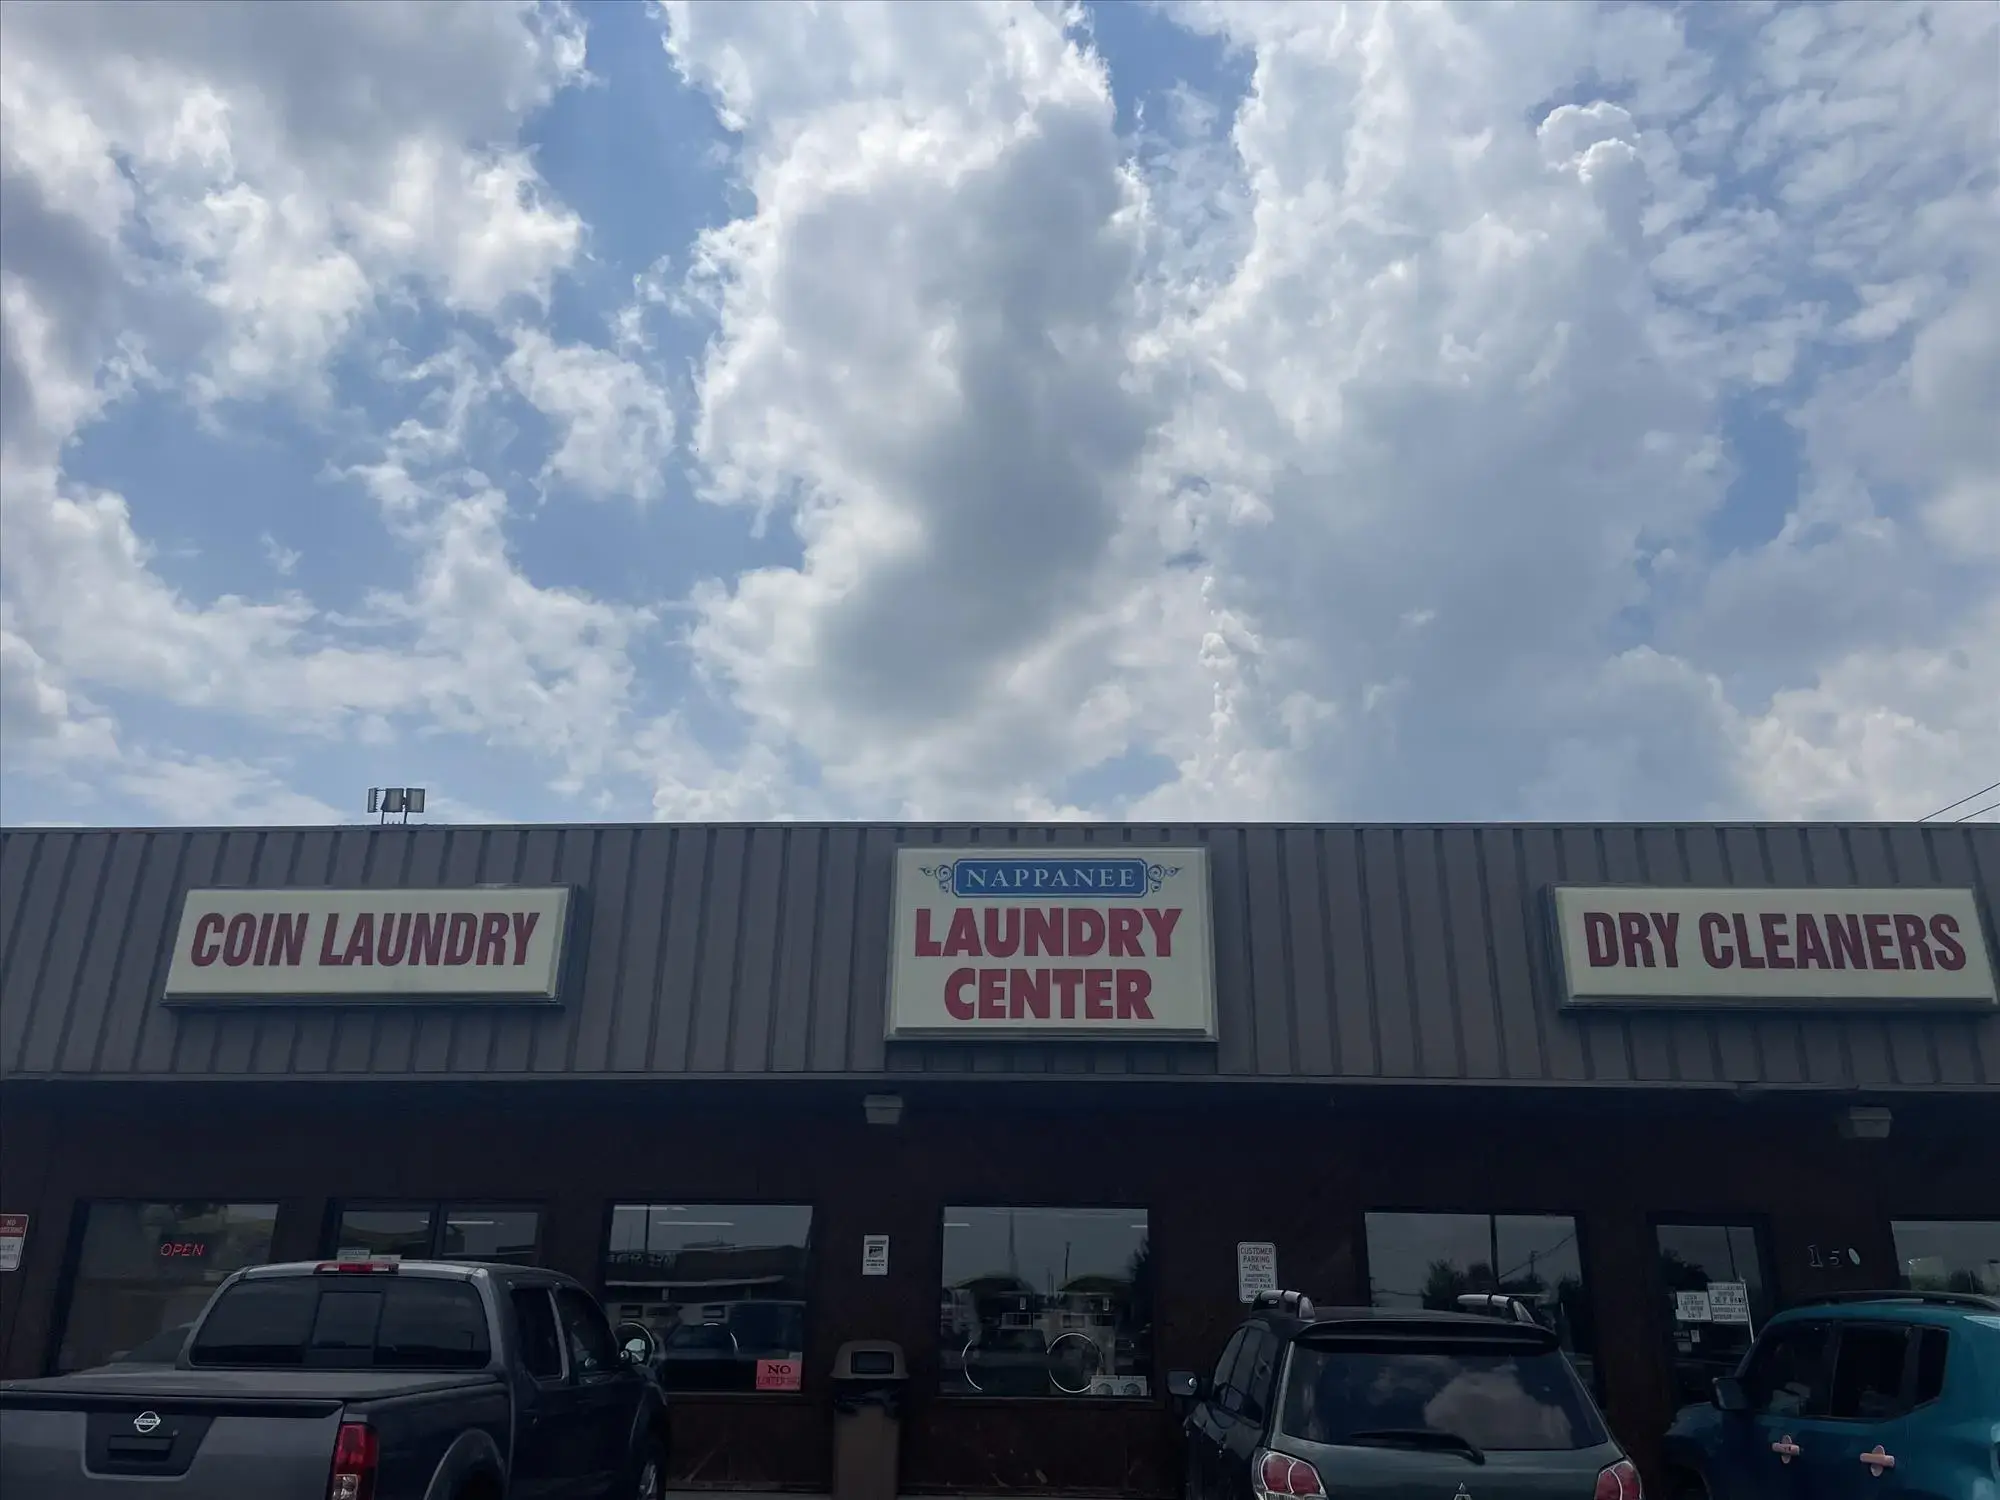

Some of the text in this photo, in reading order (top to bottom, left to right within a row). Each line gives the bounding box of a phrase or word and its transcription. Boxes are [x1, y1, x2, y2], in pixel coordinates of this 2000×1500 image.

[966, 868, 1136, 888] NAPPANEE
[190, 912, 541, 967] COIN LAUNDRY
[914, 907, 1183, 959] LAUNDRY
[1583, 912, 1967, 971] DRY CLEANERS
[944, 967, 1155, 1020] CENTER
[160, 1243, 205, 1257] OPEN
[1240, 1247, 1273, 1255] CUSTOMER
[1243, 1255, 1270, 1264] PARKING
[767, 1364, 791, 1374] NO
